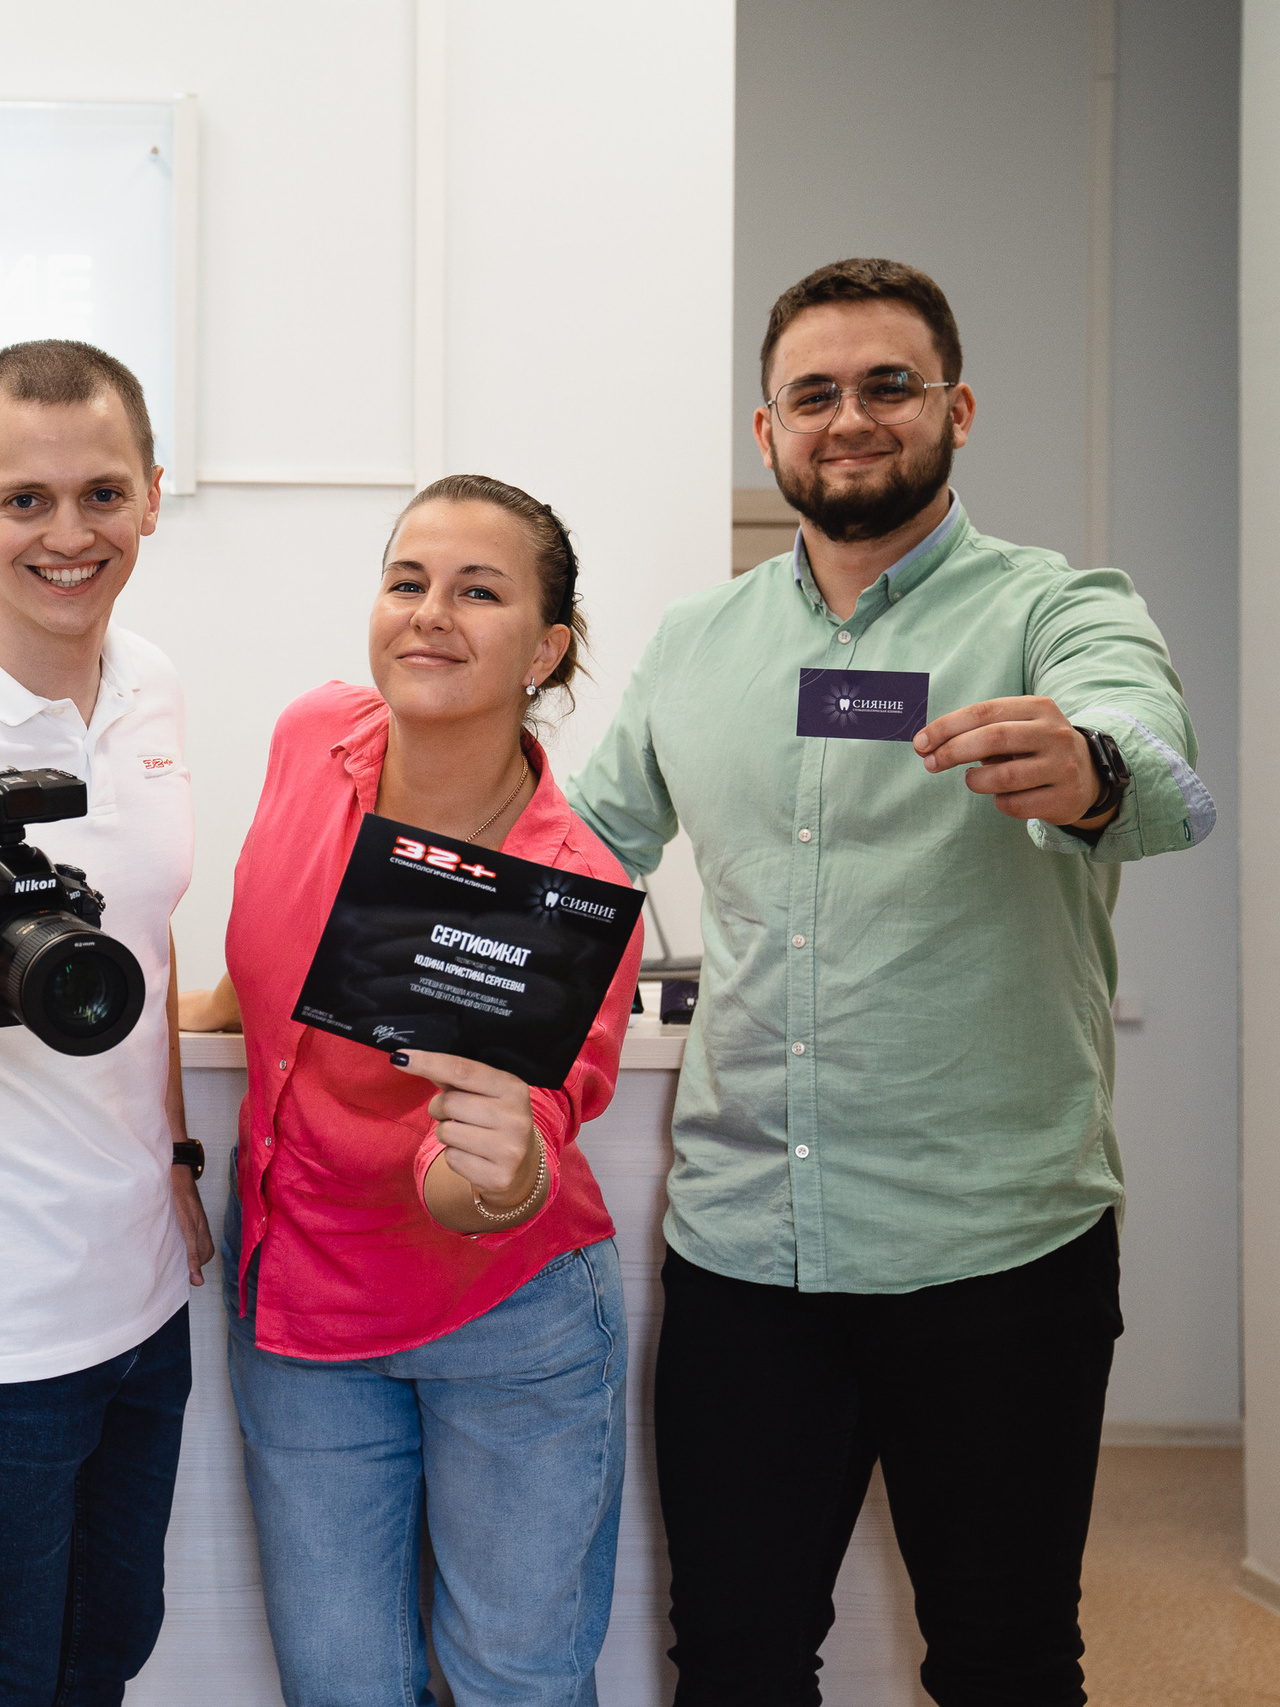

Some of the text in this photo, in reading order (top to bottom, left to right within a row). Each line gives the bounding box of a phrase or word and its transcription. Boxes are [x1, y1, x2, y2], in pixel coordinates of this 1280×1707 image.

[853, 699, 903, 710] СИЯНИЕ
[390, 857, 496, 893] СТОМАТОЛОГИЧЕСКАЯ КЛИНИКА
[393, 836, 496, 878] 32+
[15, 879, 56, 893] Nikon
[560, 896, 616, 919] СИЯНИЕ
[431, 924, 531, 967] СЕРТИФИКАТ
[414, 954, 444, 971] ЮДИНА
[445, 963, 485, 982] КРИСТИНА
[485, 974, 526, 993] СЕРГЕЕВНА
